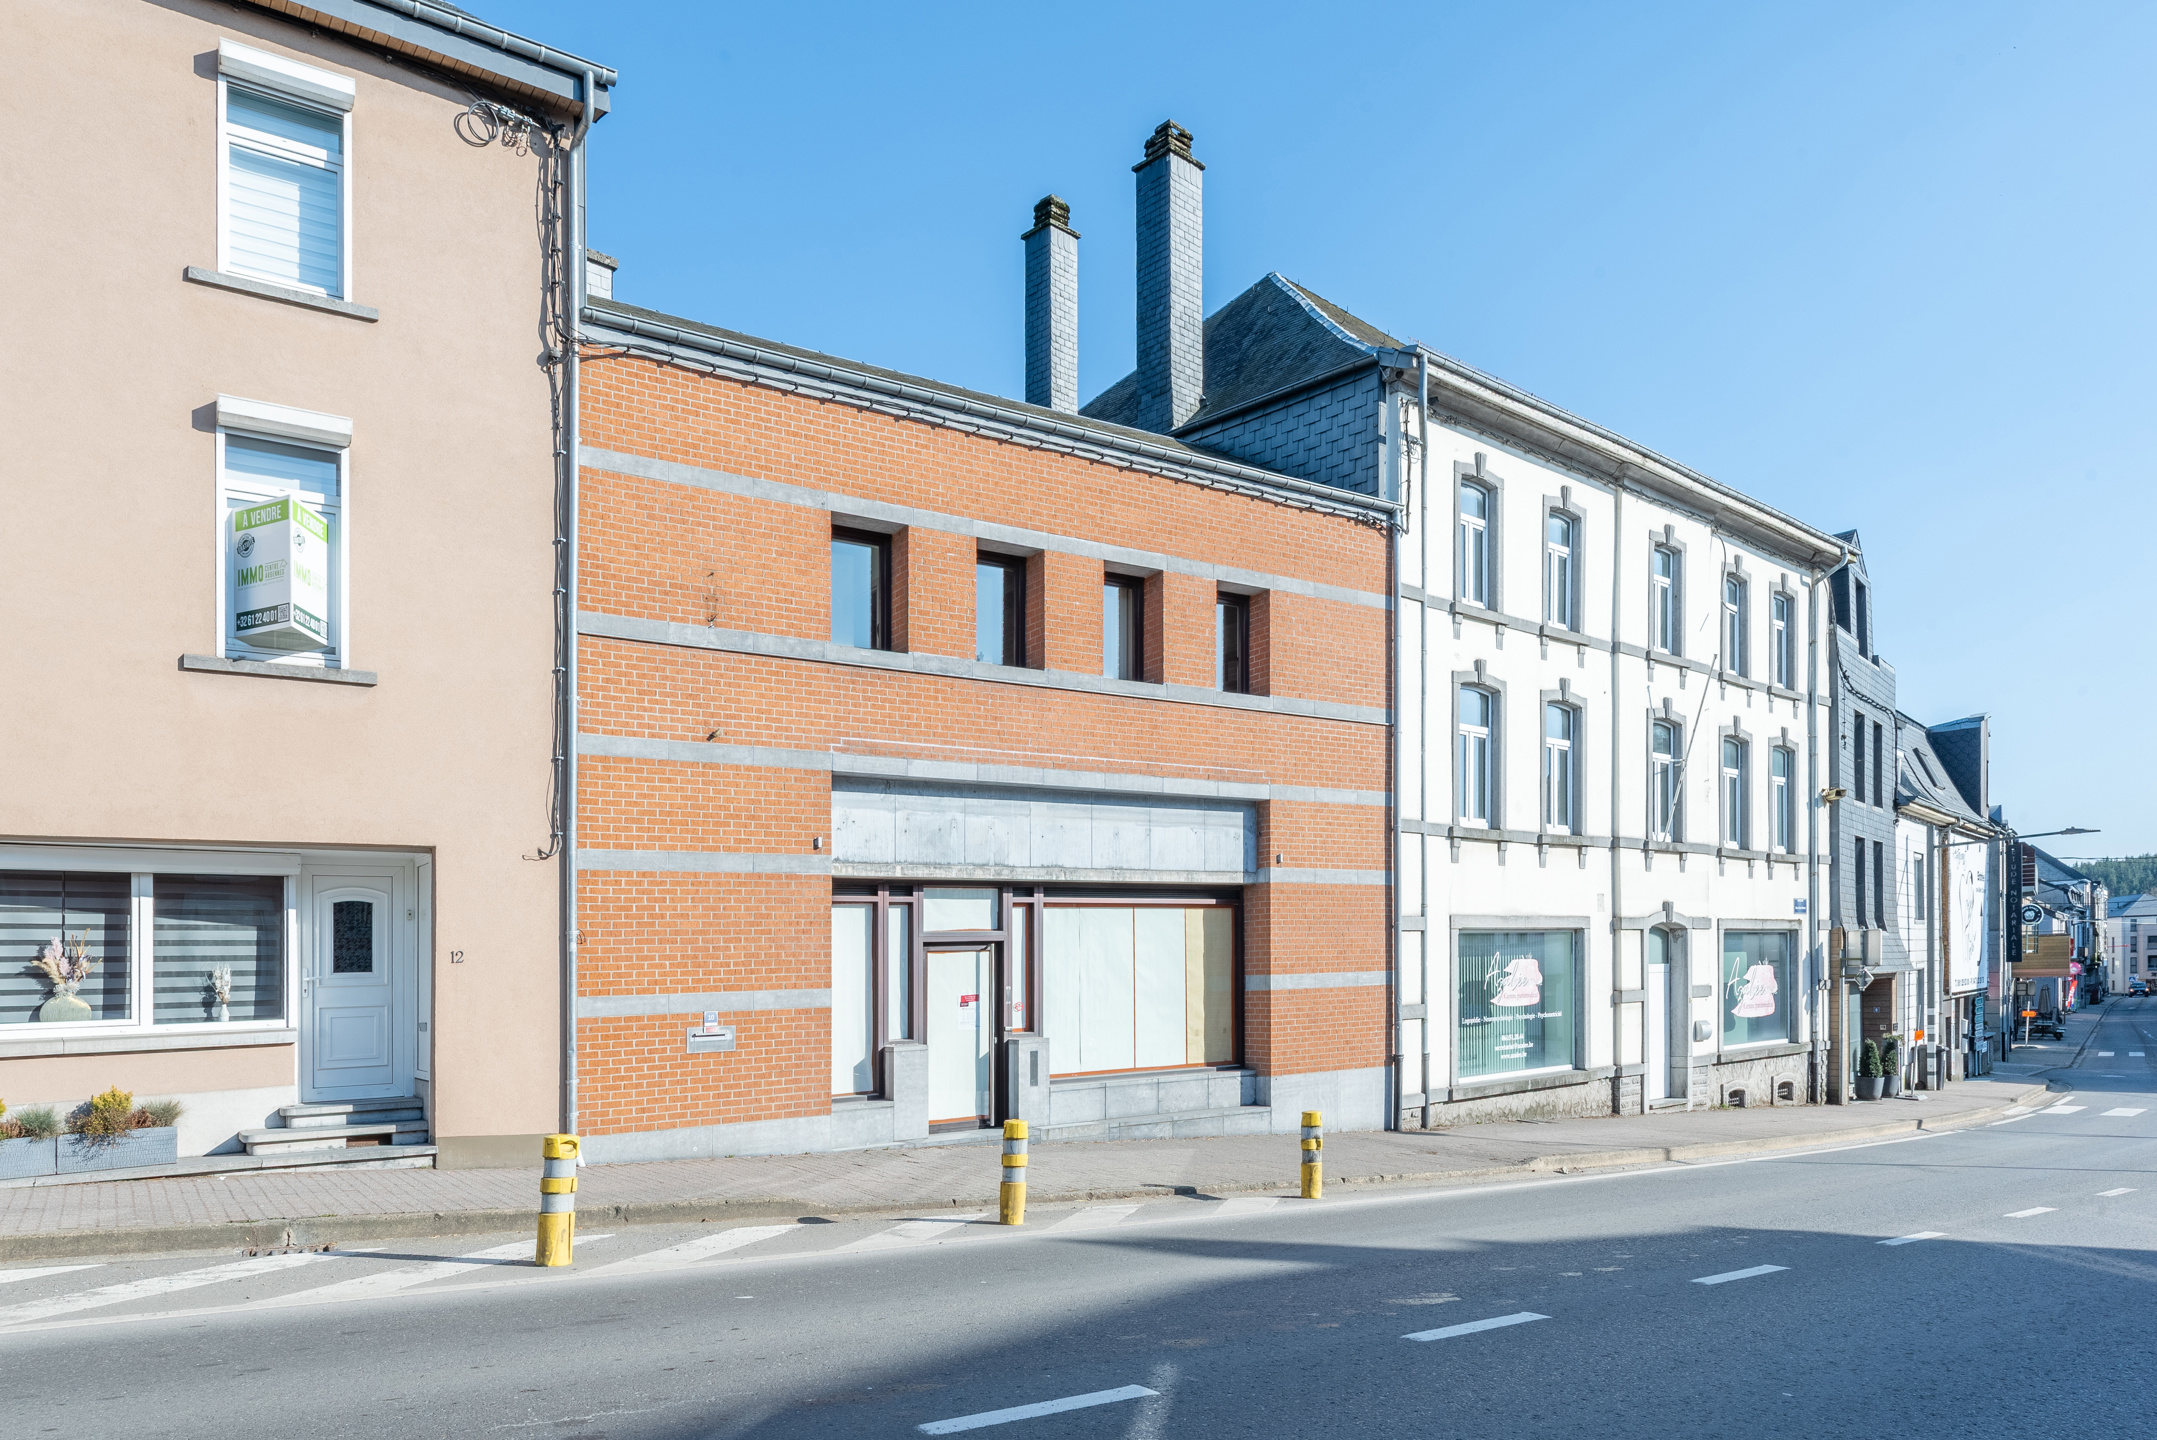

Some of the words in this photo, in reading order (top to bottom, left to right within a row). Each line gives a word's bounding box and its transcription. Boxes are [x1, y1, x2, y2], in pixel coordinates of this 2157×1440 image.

[243, 511, 248, 527] À
[251, 505, 282, 525] VENDRE
[265, 563, 279, 572] CENTRE
[265, 569, 284, 578] ARDENNES
[237, 564, 263, 587] IMMO
[237, 616, 247, 627] +32
[248, 615, 254, 626] 61
[255, 613, 262, 624] 22
[271, 610, 277, 621] 01
[450, 950, 464, 964] 12
